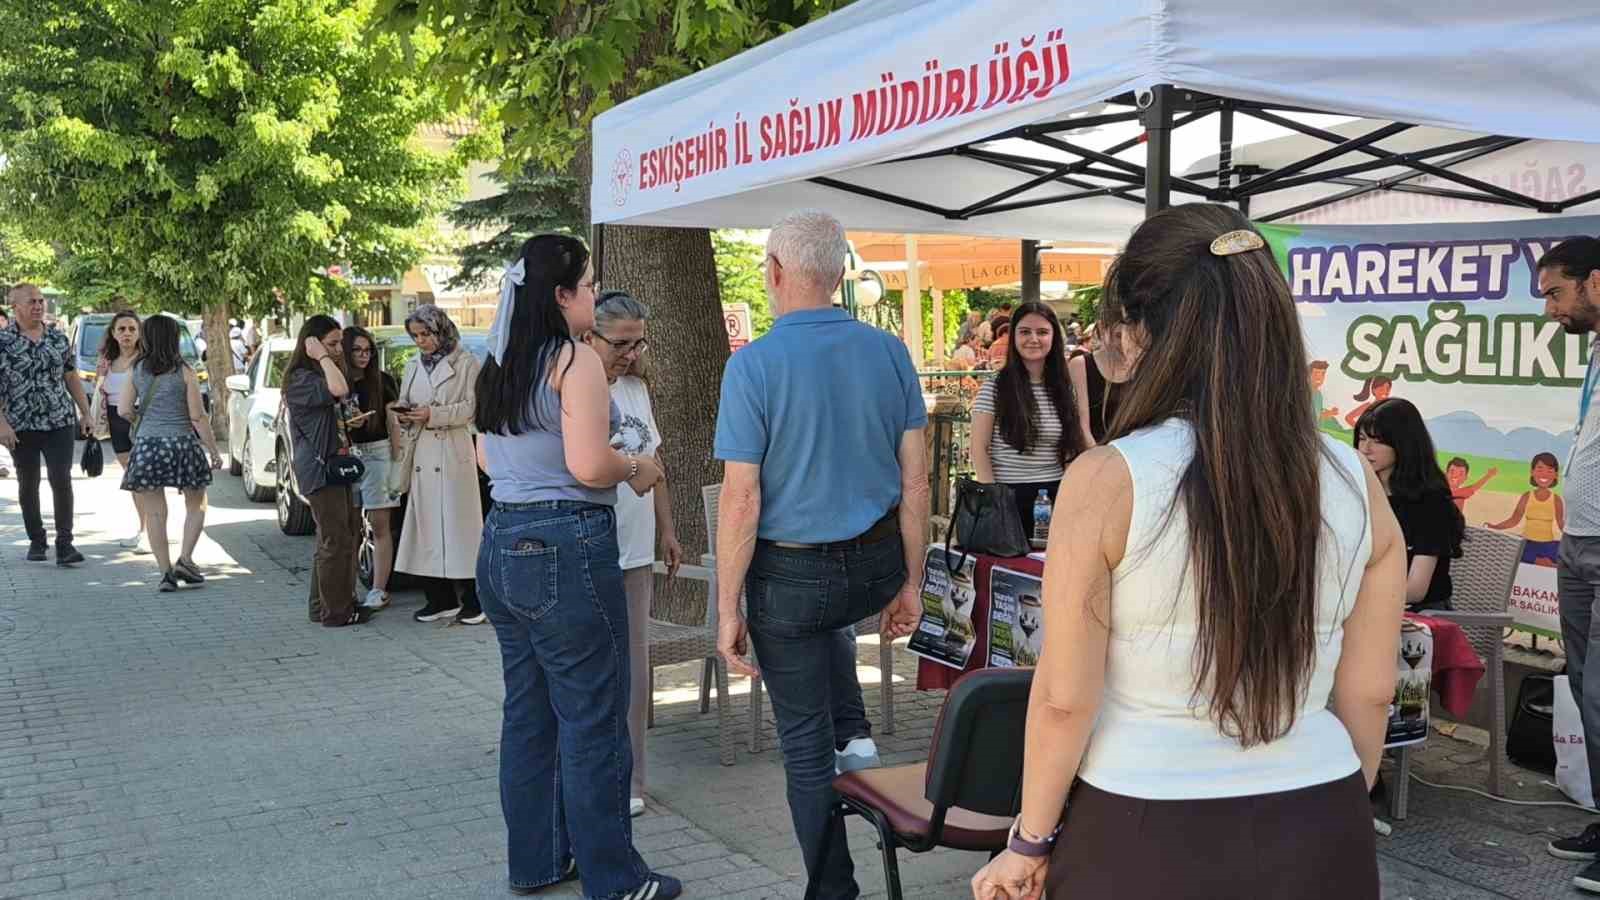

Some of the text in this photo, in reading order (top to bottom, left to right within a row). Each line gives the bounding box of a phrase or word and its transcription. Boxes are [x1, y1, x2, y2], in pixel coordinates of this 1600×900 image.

[639, 28, 1070, 192] ESKİŞEHİR İL SAĞLIK MÜDÜRLÜĞÜ
[971, 262, 1074, 279] LA GELERIA
[1292, 243, 1513, 296] HAREKET
